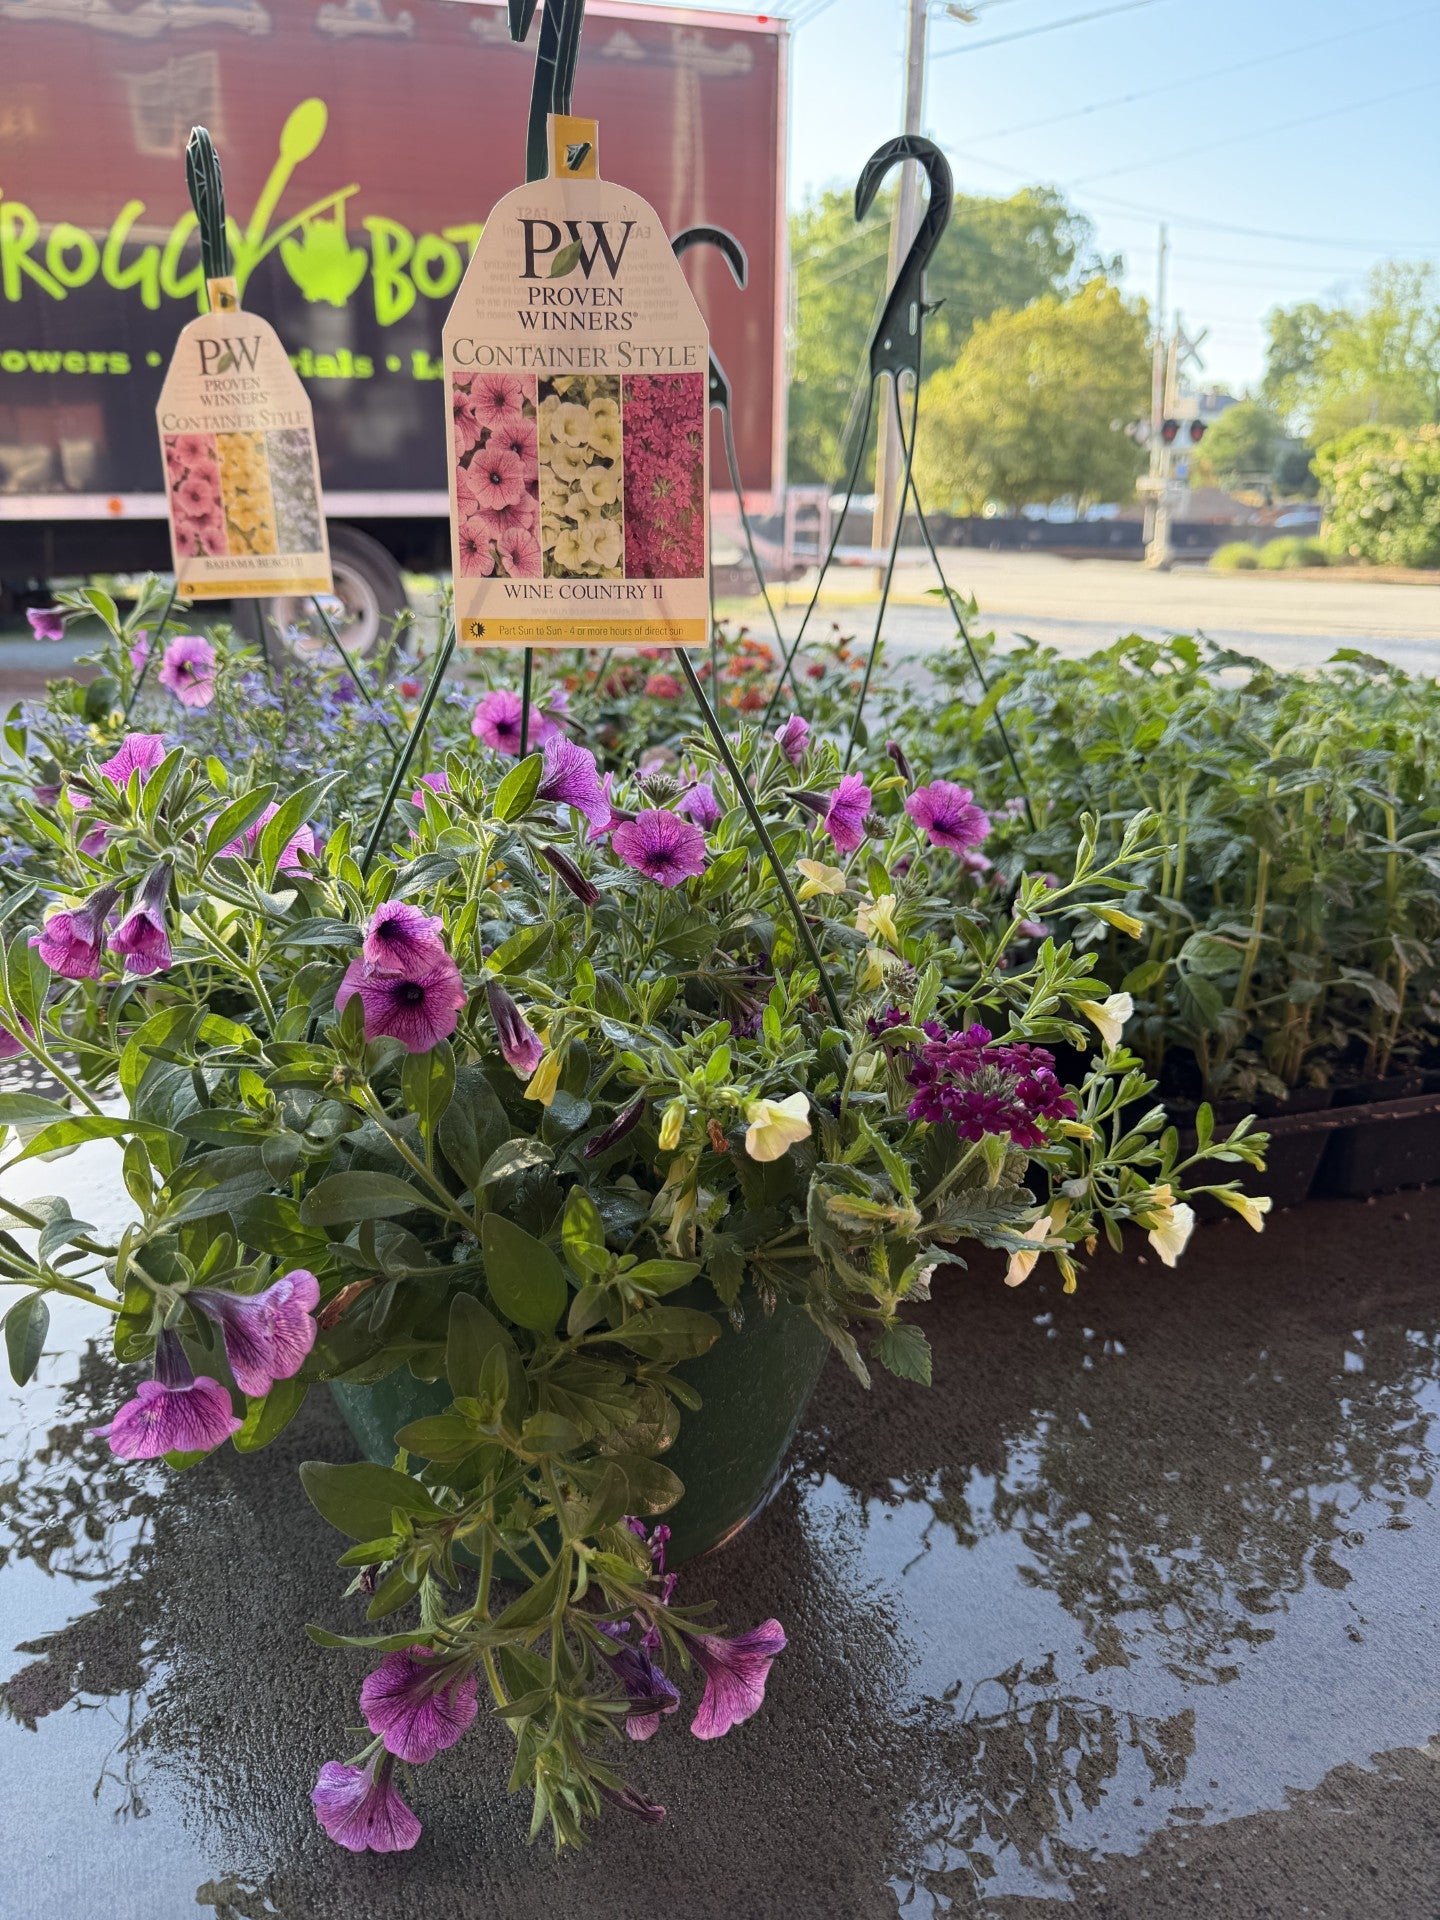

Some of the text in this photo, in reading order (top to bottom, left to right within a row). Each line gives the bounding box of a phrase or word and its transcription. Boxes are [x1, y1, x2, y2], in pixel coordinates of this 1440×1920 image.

[517, 218, 637, 280] PW
[527, 287, 623, 307] PROVEN
[0, 350, 131, 374] owers
[195, 336, 261, 376] PW
[452, 338, 606, 368] CONTAINER
[204, 376, 261, 392] PROVEN
[162, 412, 256, 431] CONTAINER
[504, 584, 663, 600] WINE COUNTRY II
[499, 626, 516, 635] Part
[518, 626, 533, 635] Sun
[536, 627, 544, 635] to
[547, 626, 562, 635] Sun
[569, 626, 575, 635] 4
[610, 626, 632, 636] hours
[634, 626, 643, 635] of
[645, 626, 668, 636] direct
